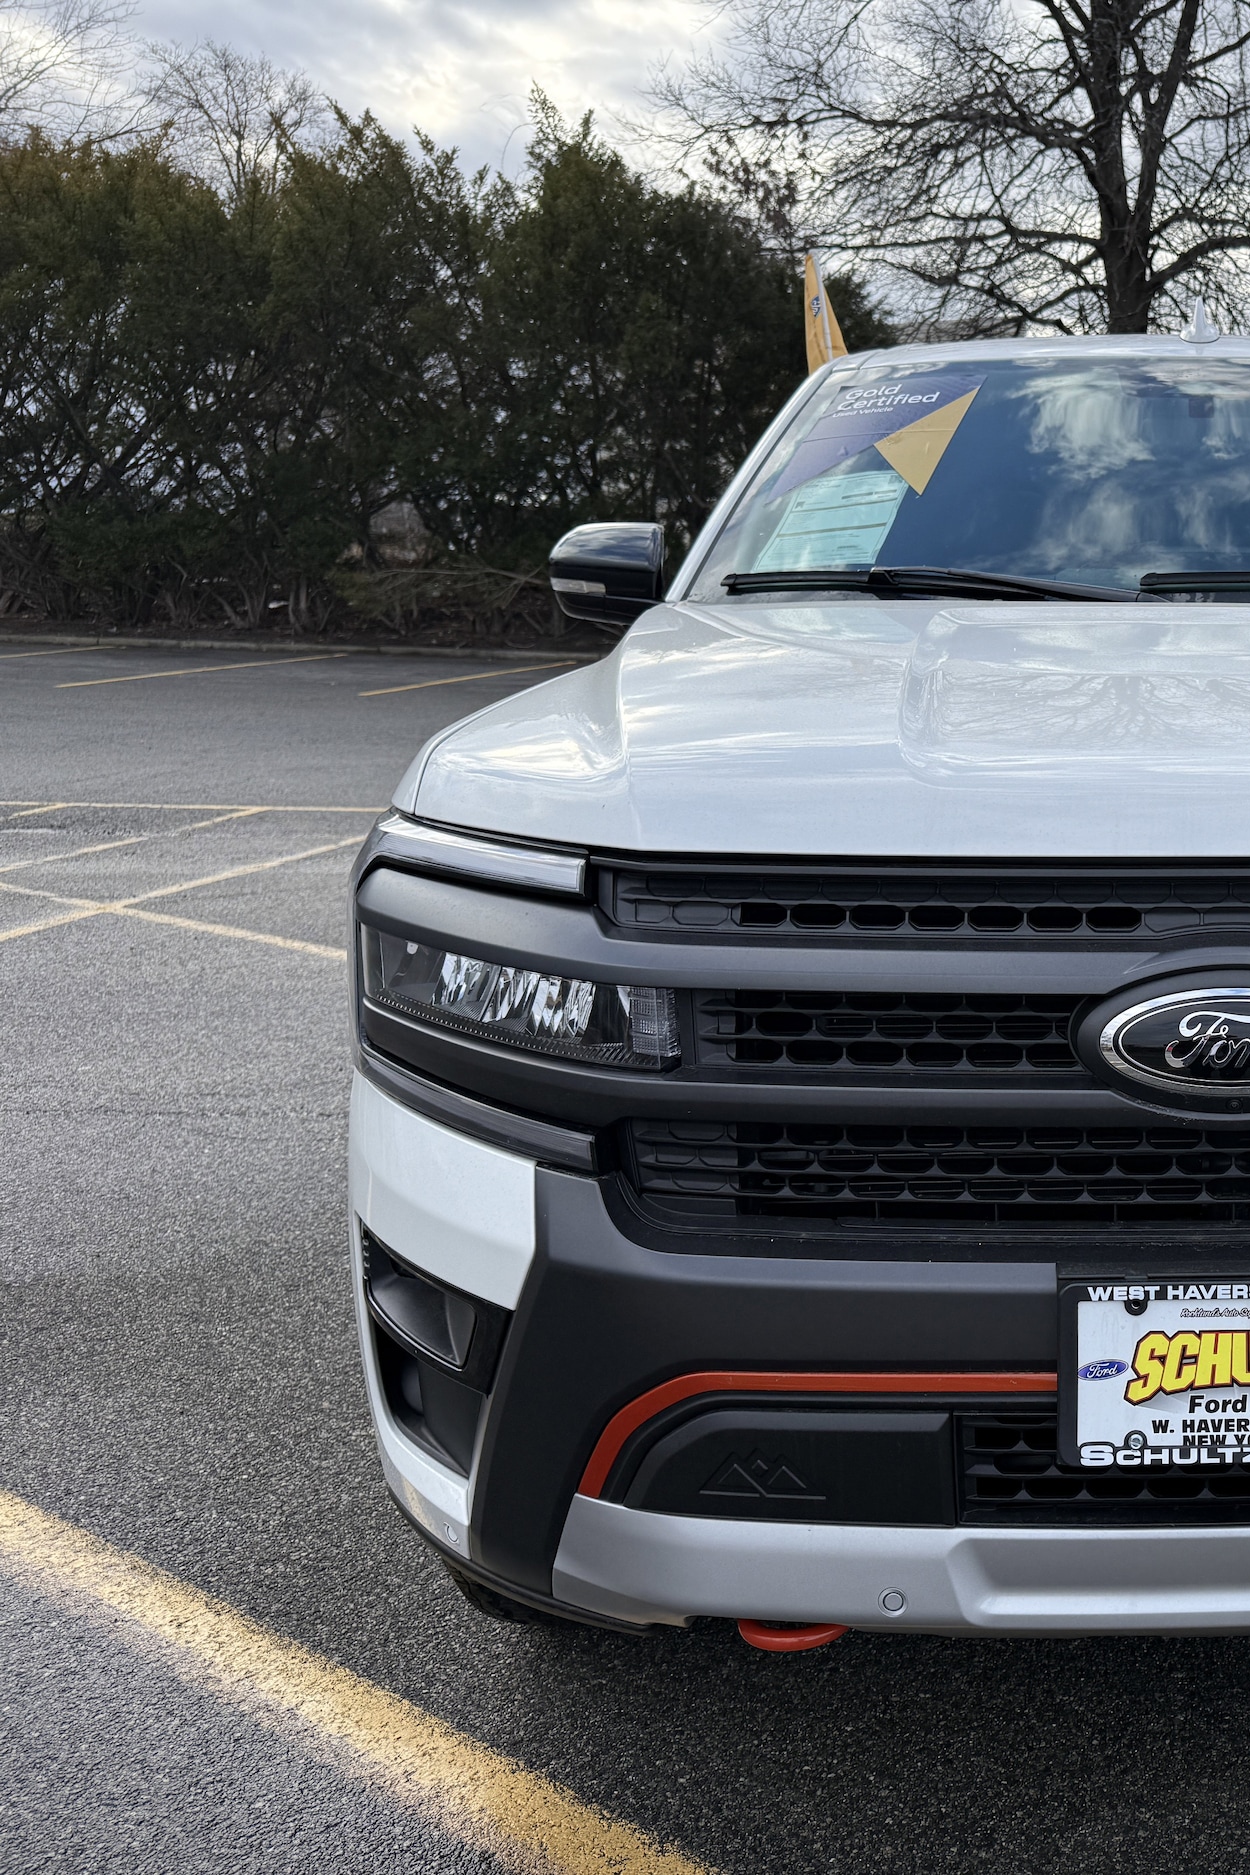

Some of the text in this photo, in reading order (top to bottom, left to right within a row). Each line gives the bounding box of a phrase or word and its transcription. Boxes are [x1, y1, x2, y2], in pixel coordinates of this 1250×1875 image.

[845, 383, 903, 400] Gold
[837, 391, 941, 411] Certified
[859, 406, 894, 415] Vehicle
[1087, 1285, 1160, 1301] WEST
[1086, 1362, 1118, 1378] Ford
[1188, 1394, 1249, 1414] Ford
[1151, 1419, 1175, 1434] W.
[1182, 1434, 1227, 1446] NEW
